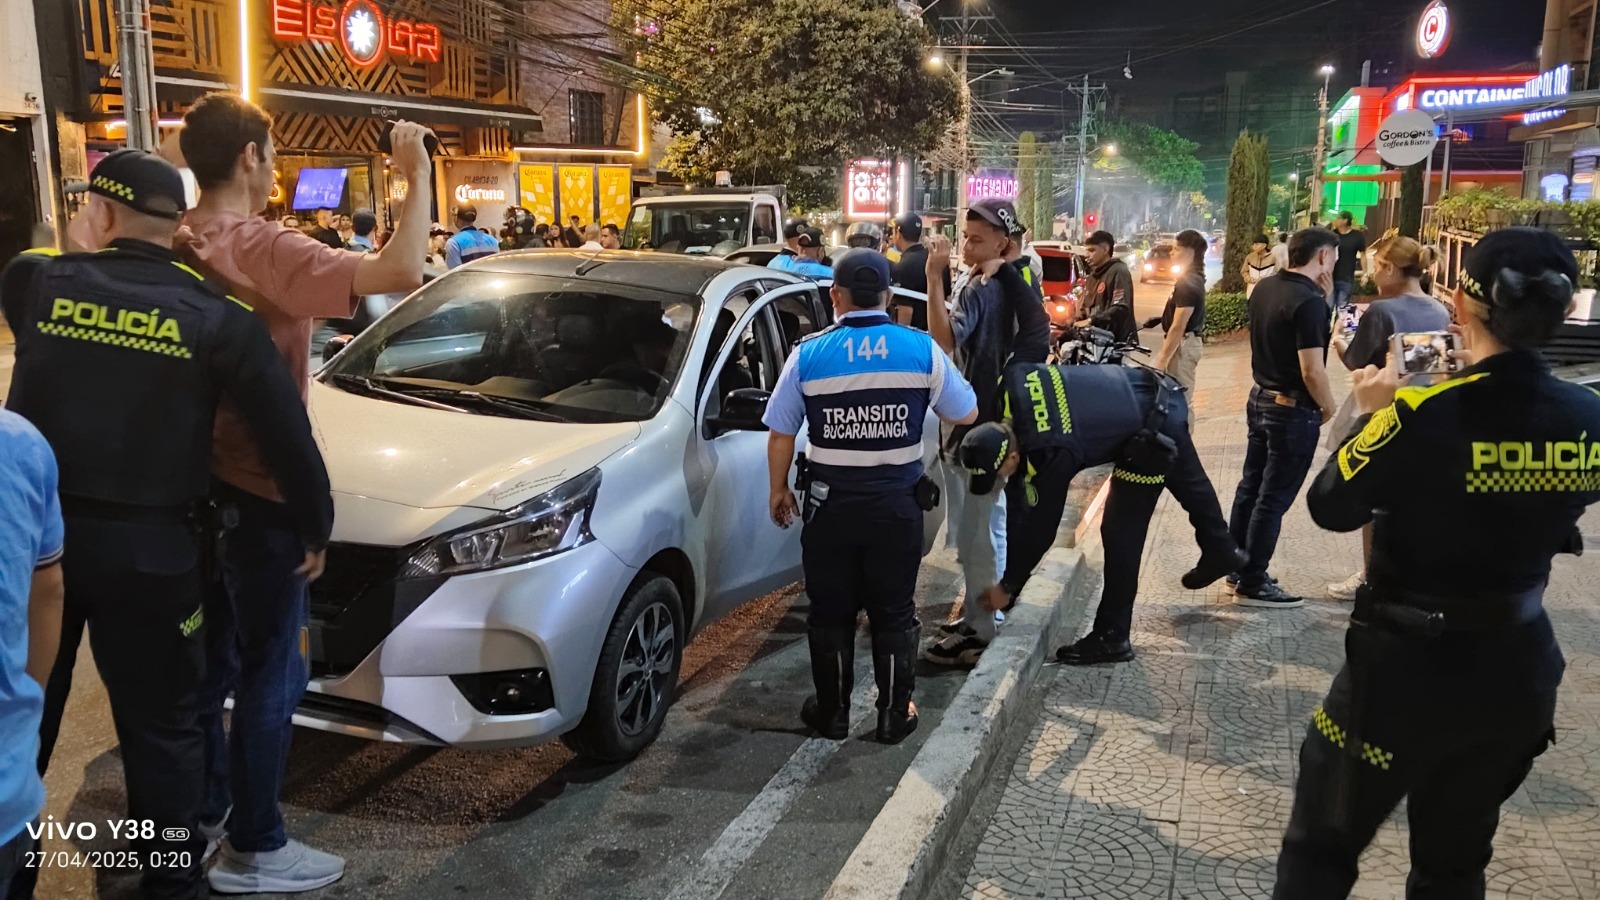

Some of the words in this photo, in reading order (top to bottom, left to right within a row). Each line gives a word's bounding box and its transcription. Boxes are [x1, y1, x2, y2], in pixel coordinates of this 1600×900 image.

[51, 298, 181, 342] POLICÍA
[843, 335, 889, 362] 144
[823, 404, 909, 424] TRANSITO
[1024, 369, 1052, 433] POLICÍA
[823, 421, 908, 439] BUCARAMANGA
